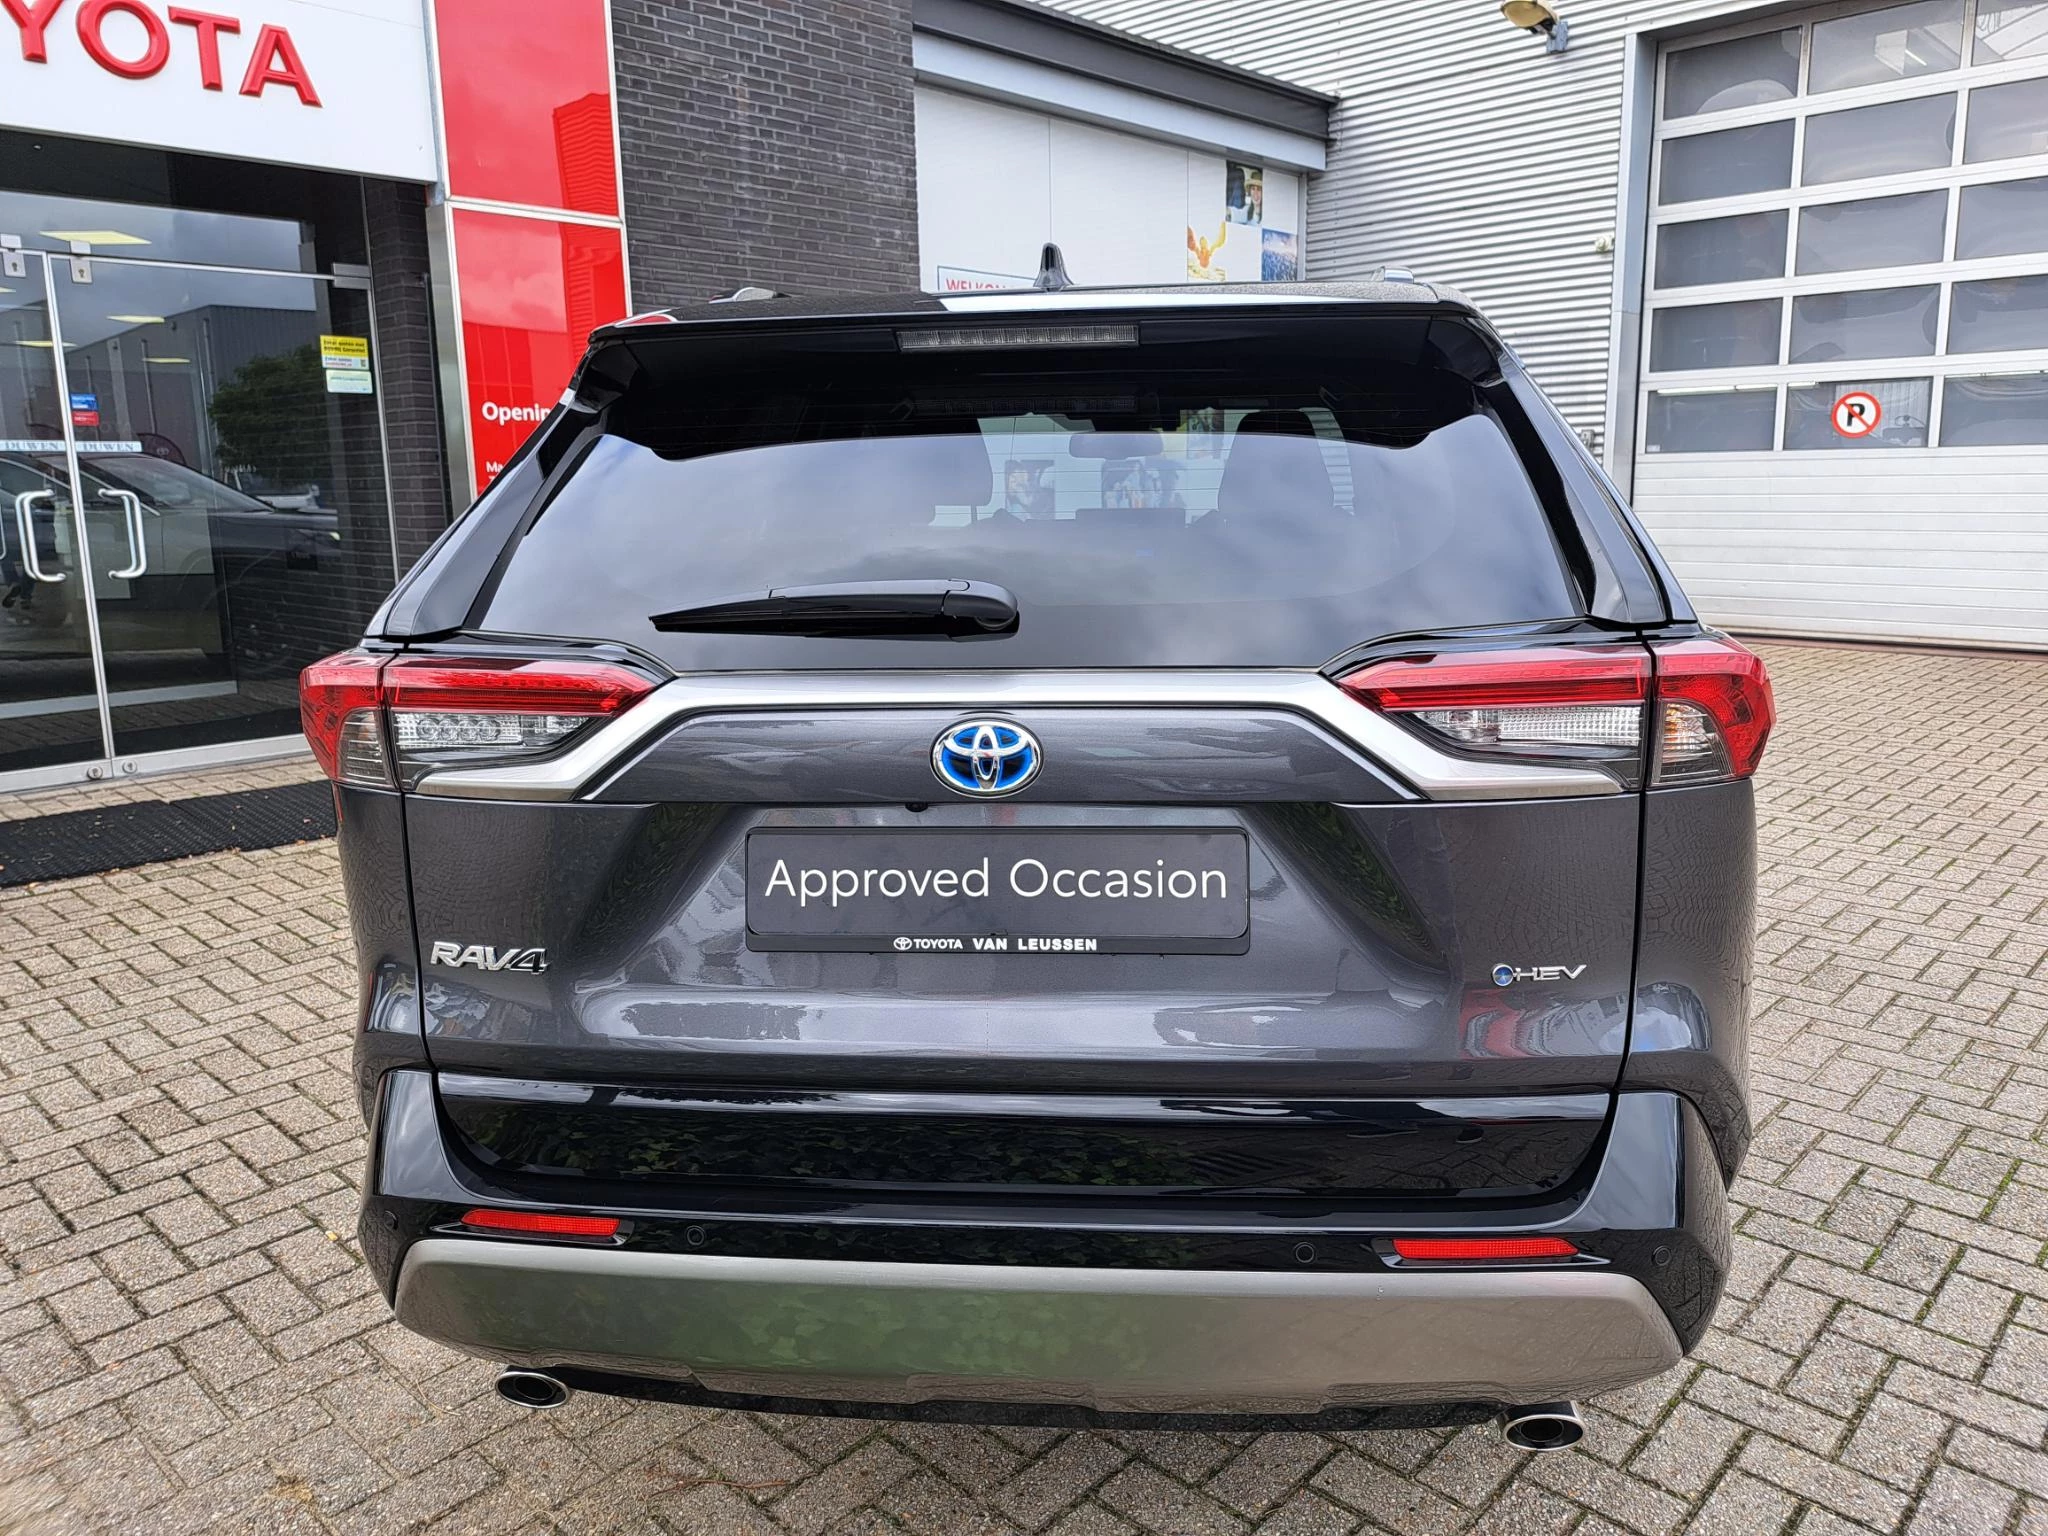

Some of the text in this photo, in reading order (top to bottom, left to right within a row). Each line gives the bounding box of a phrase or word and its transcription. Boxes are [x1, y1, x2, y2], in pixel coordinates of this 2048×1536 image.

[1846, 403, 1865, 427] P
[5, 442, 59, 450] DUWEN
[83, 443, 134, 451] DUWEN
[765, 857, 1227, 907] Approved Occasion
[913, 938, 1097, 951] TOYOTA VAN LEUSSEN
[430, 941, 549, 975] RAV4
